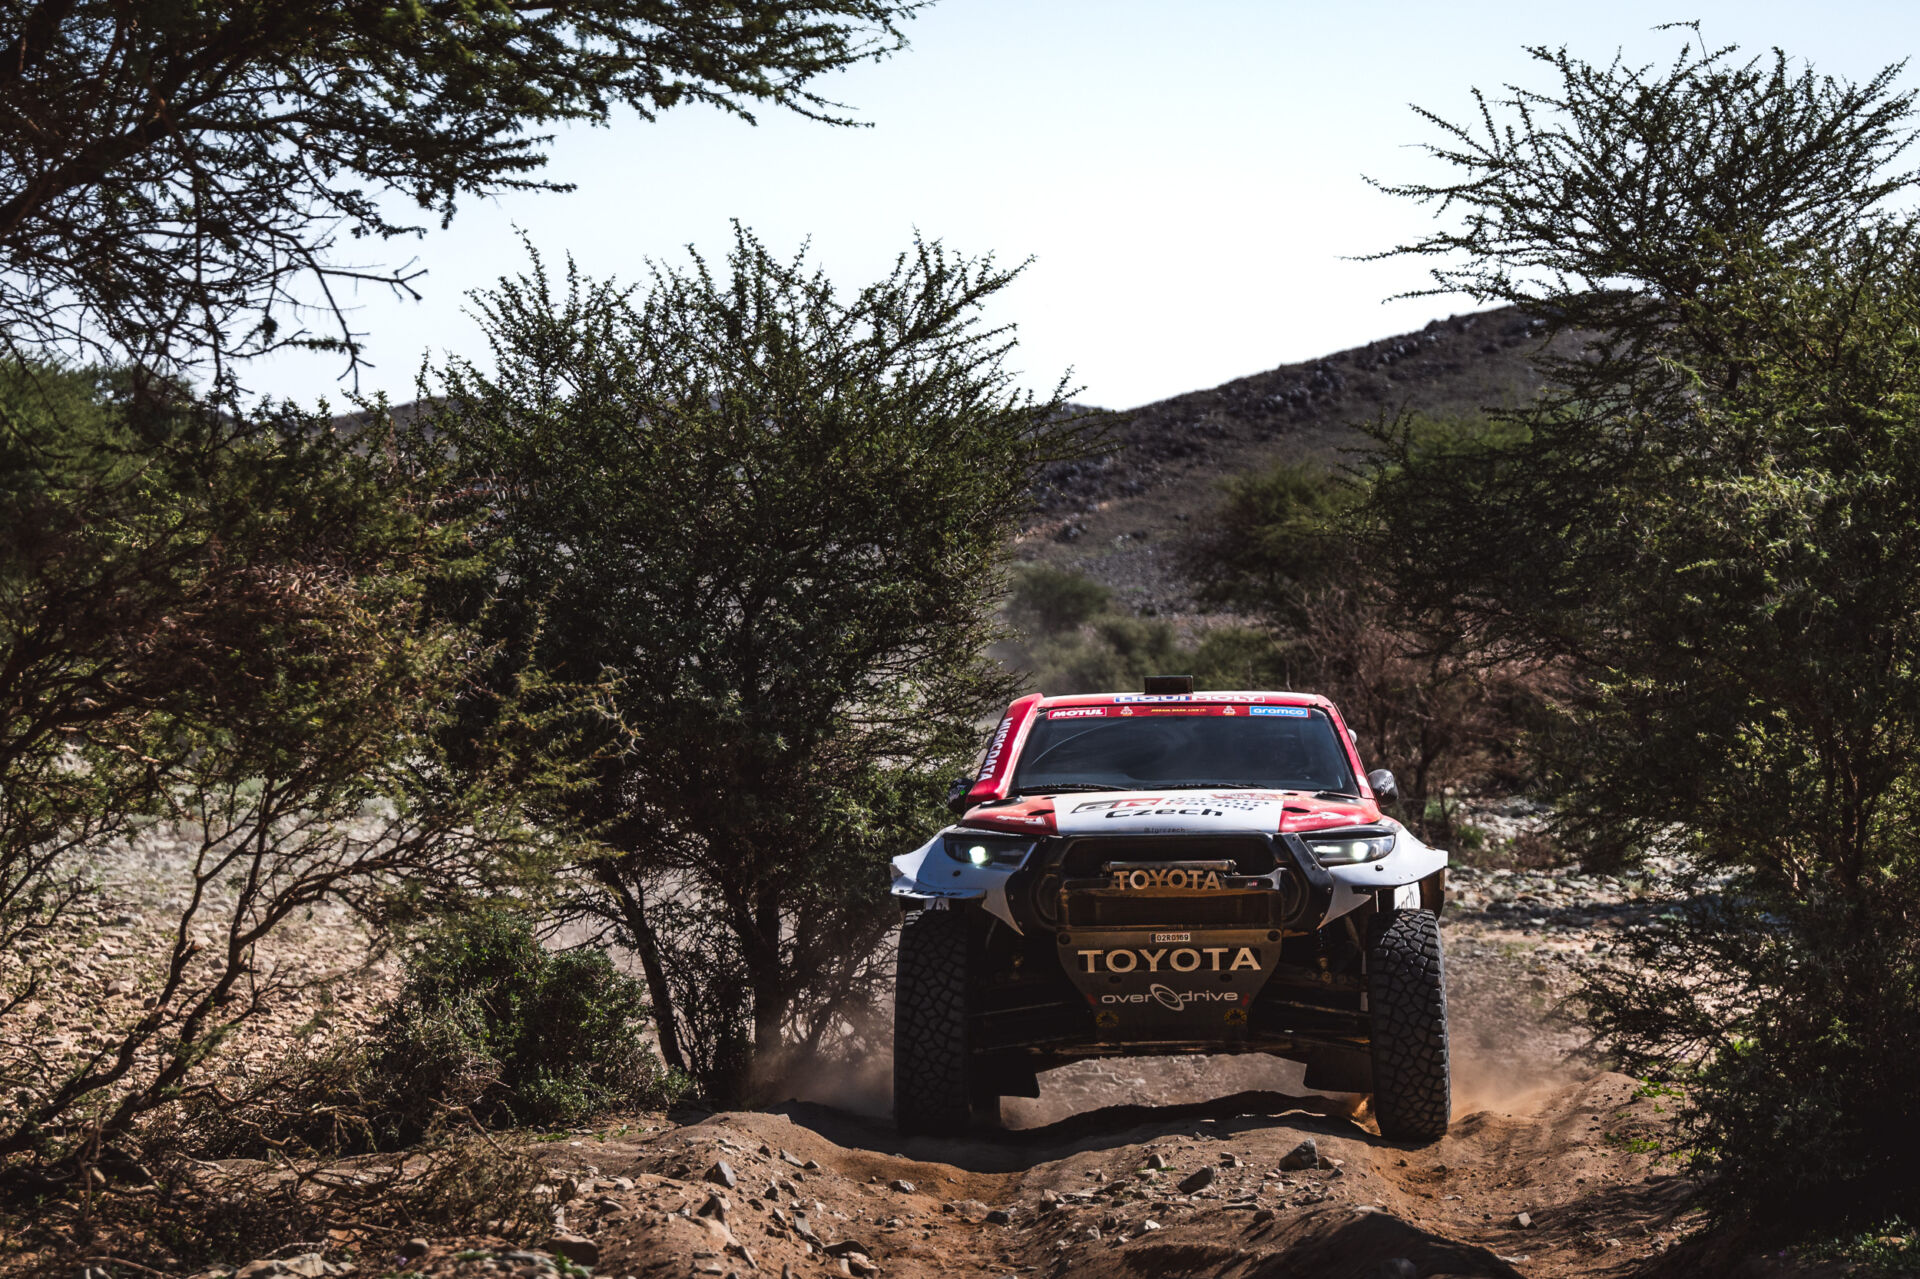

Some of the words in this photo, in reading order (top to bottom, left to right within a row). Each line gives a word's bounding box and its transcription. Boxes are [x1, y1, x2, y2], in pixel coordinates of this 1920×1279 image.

[1052, 708, 1104, 718] MOTUL
[1253, 707, 1305, 716] aramco
[979, 717, 1014, 782] MUSICDATA
[1105, 808, 1223, 819] Czech
[1113, 868, 1222, 891] TOYOTA
[1077, 947, 1262, 973] TOYOTA
